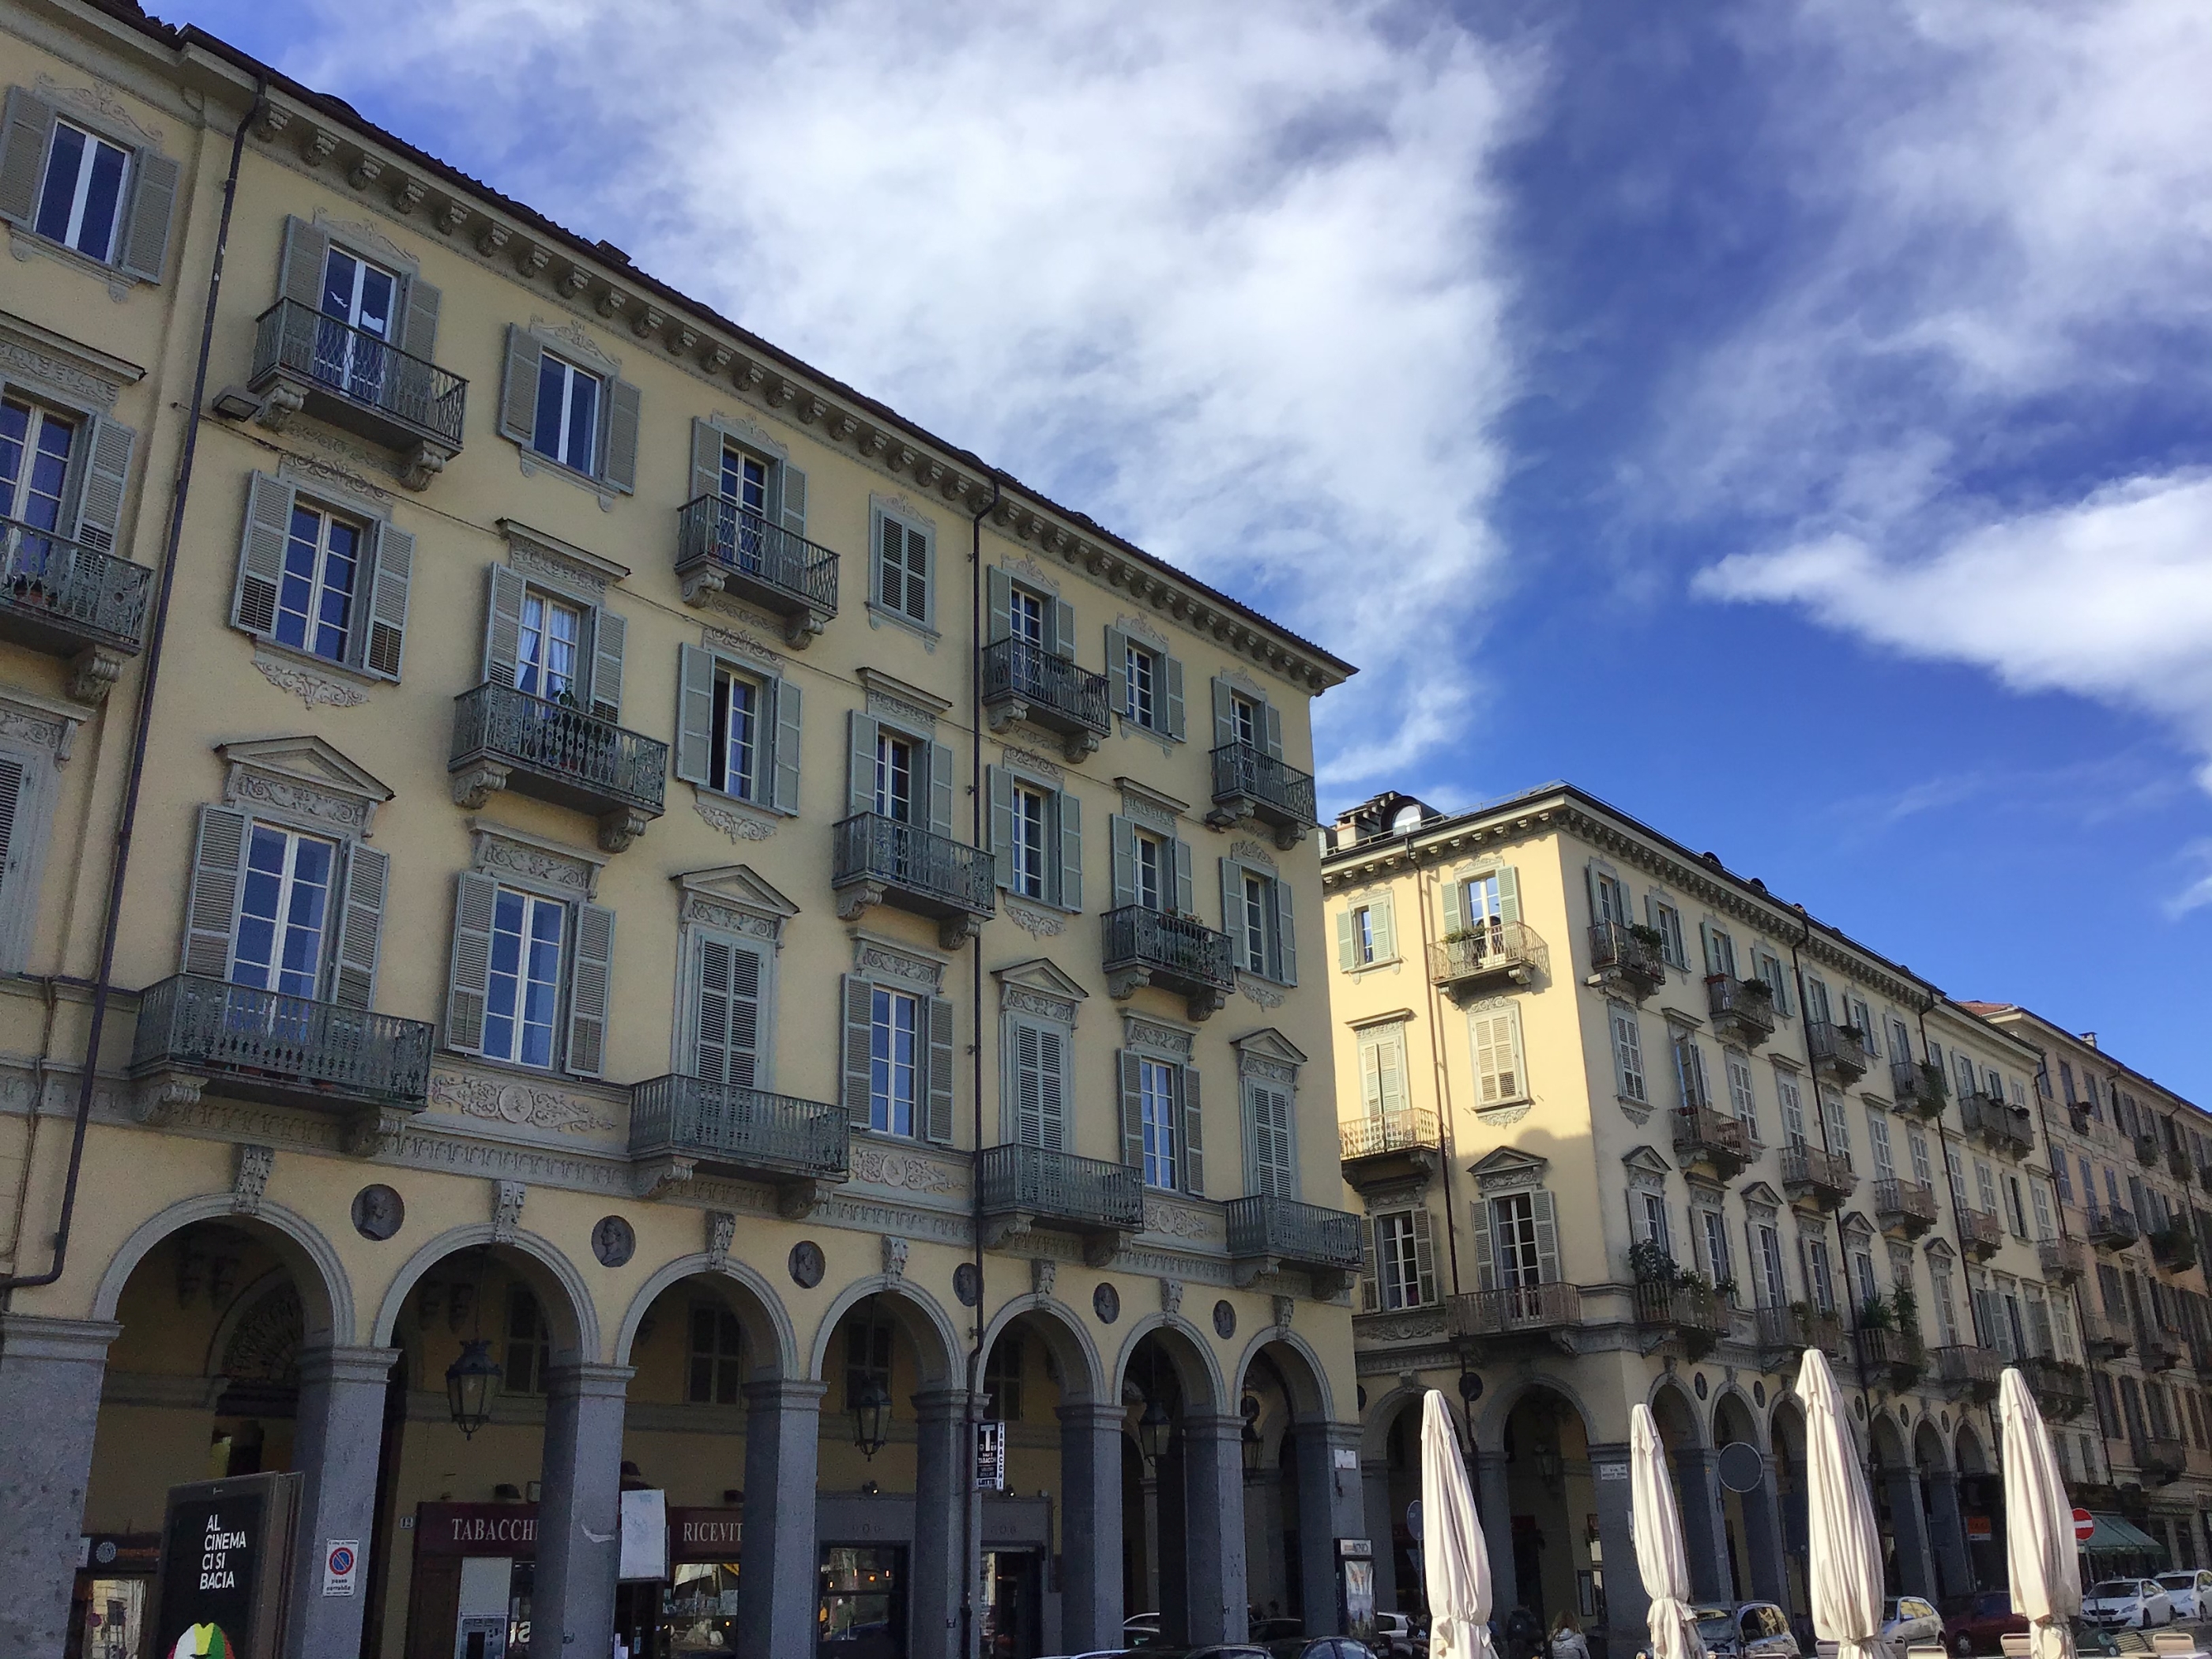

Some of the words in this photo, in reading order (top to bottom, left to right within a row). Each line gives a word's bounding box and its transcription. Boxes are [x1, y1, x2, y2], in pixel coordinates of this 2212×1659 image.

[206, 1514, 220, 1532] AL
[205, 1531, 246, 1551] CINEMA
[202, 1553, 213, 1571] CI
[215, 1552, 226, 1569] SI
[200, 1571, 235, 1589] BACIA
